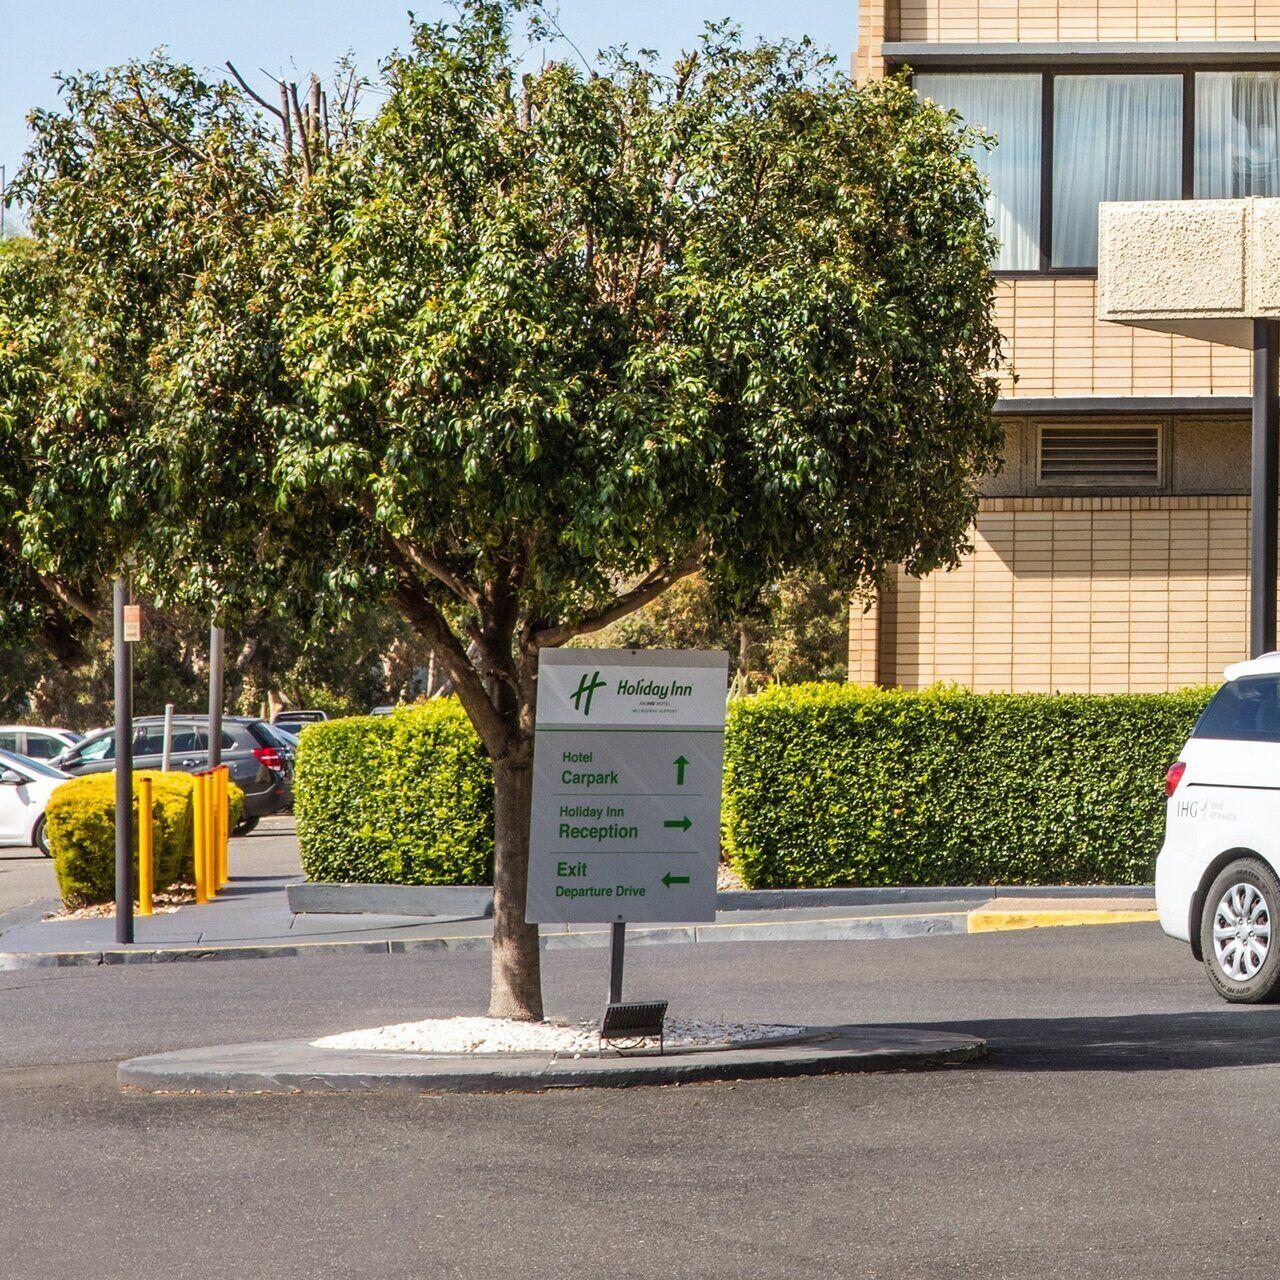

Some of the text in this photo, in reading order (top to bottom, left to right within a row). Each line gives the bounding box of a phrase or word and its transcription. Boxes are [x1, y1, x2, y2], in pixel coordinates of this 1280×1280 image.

[617, 679, 693, 700] Holiday Inn
[563, 752, 593, 763] Hotel
[561, 770, 619, 787] Carpark
[559, 806, 624, 820] Holiday Inn
[1177, 801, 1198, 818] IHG
[559, 823, 638, 841] Reception
[557, 862, 587, 877] Exit
[555, 886, 646, 899] Departure Drive
